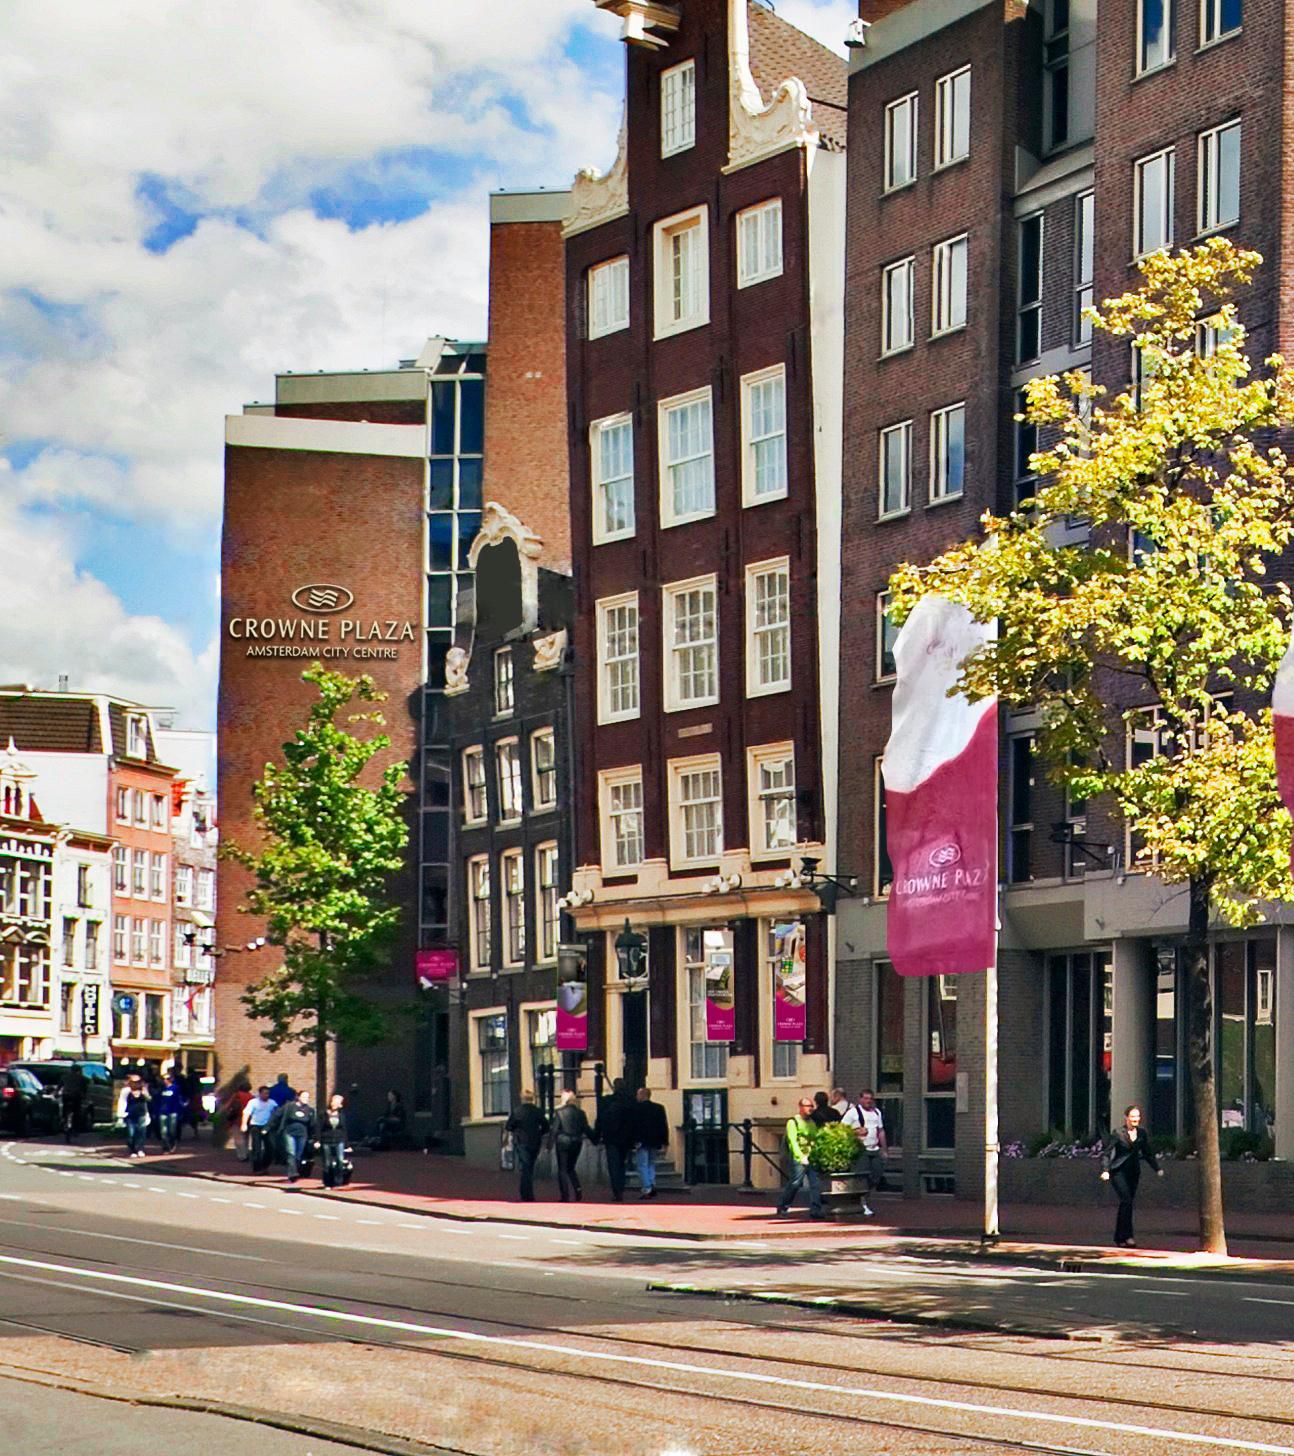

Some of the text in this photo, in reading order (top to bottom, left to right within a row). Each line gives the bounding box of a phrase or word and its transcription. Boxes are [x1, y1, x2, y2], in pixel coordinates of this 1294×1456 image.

[229, 617, 415, 641] CROWNE PLAZA
[246, 645, 398, 659] AMSTERDAM CITY CENTRE
